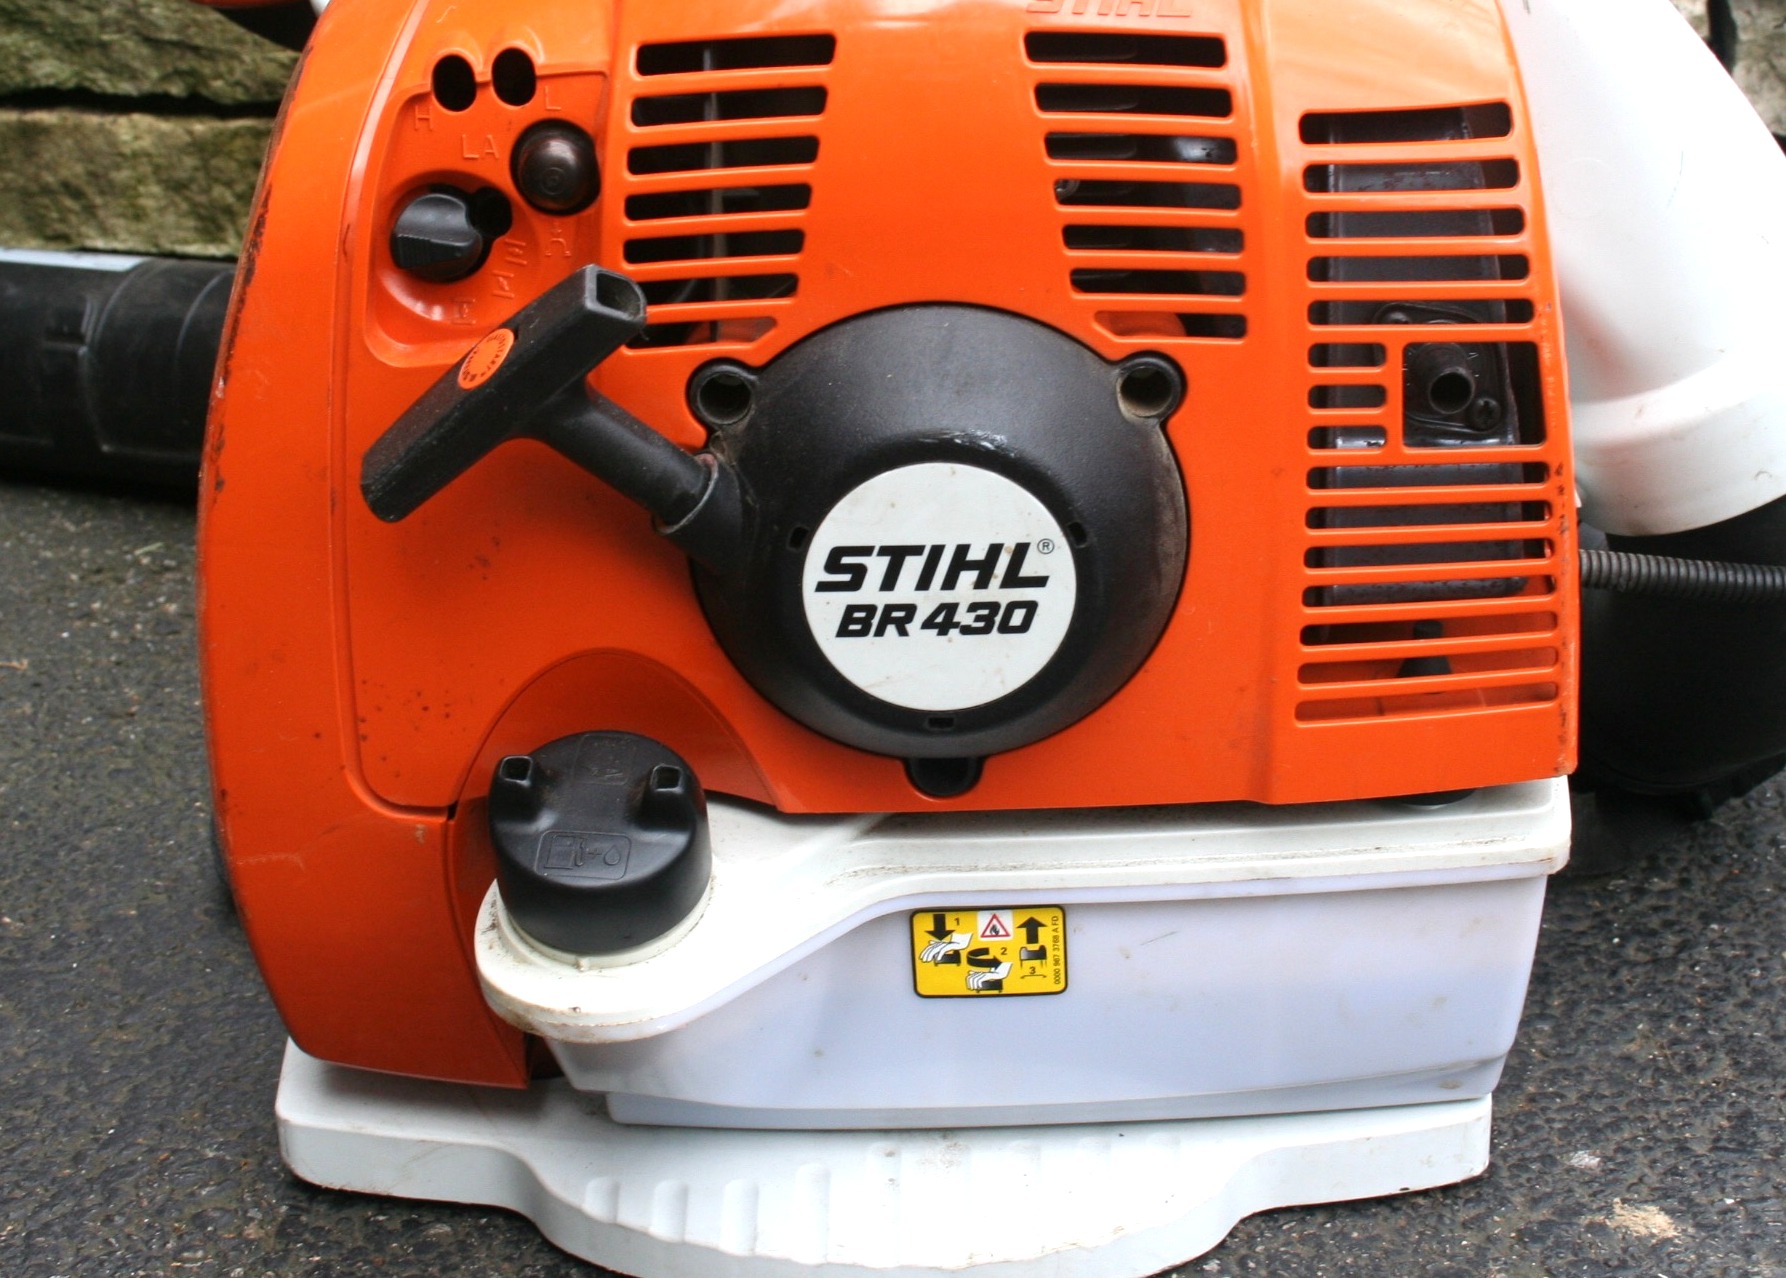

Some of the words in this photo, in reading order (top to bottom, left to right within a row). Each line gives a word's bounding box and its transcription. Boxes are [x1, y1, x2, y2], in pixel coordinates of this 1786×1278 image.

[545, 85, 562, 111] L
[414, 104, 434, 131] H
[462, 133, 499, 159] LA
[835, 603, 917, 638] BR
[920, 600, 1039, 637] 430
[954, 917, 961, 926] 1
[1000, 947, 1008, 956] 2
[1029, 966, 1036, 975] 3
